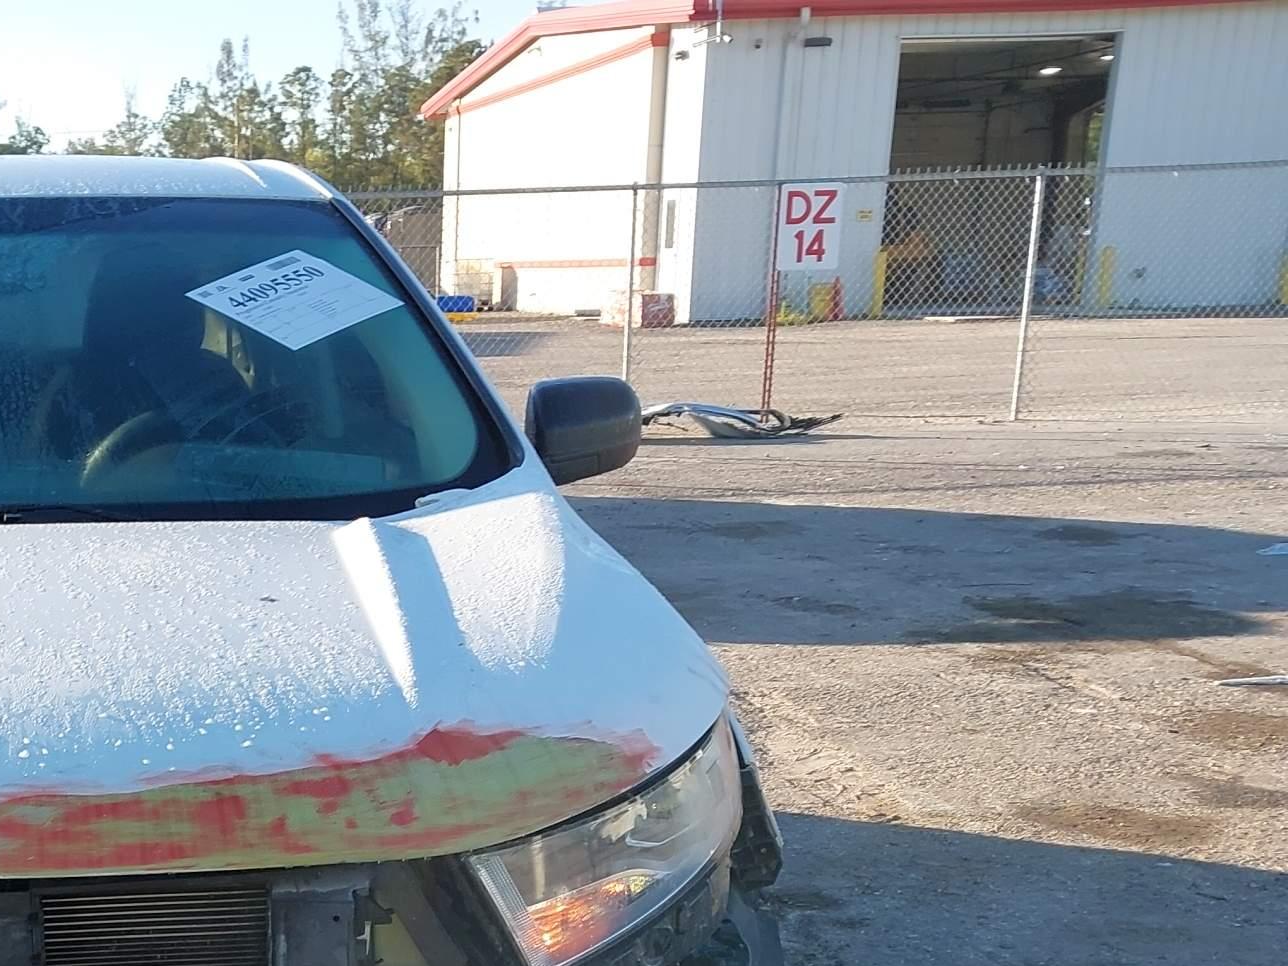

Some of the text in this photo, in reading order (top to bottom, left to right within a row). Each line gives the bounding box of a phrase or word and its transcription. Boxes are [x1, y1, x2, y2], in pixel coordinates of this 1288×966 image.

[785, 189, 838, 225] DZ
[793, 228, 826, 264] 14
[227, 265, 326, 309] 44095550
